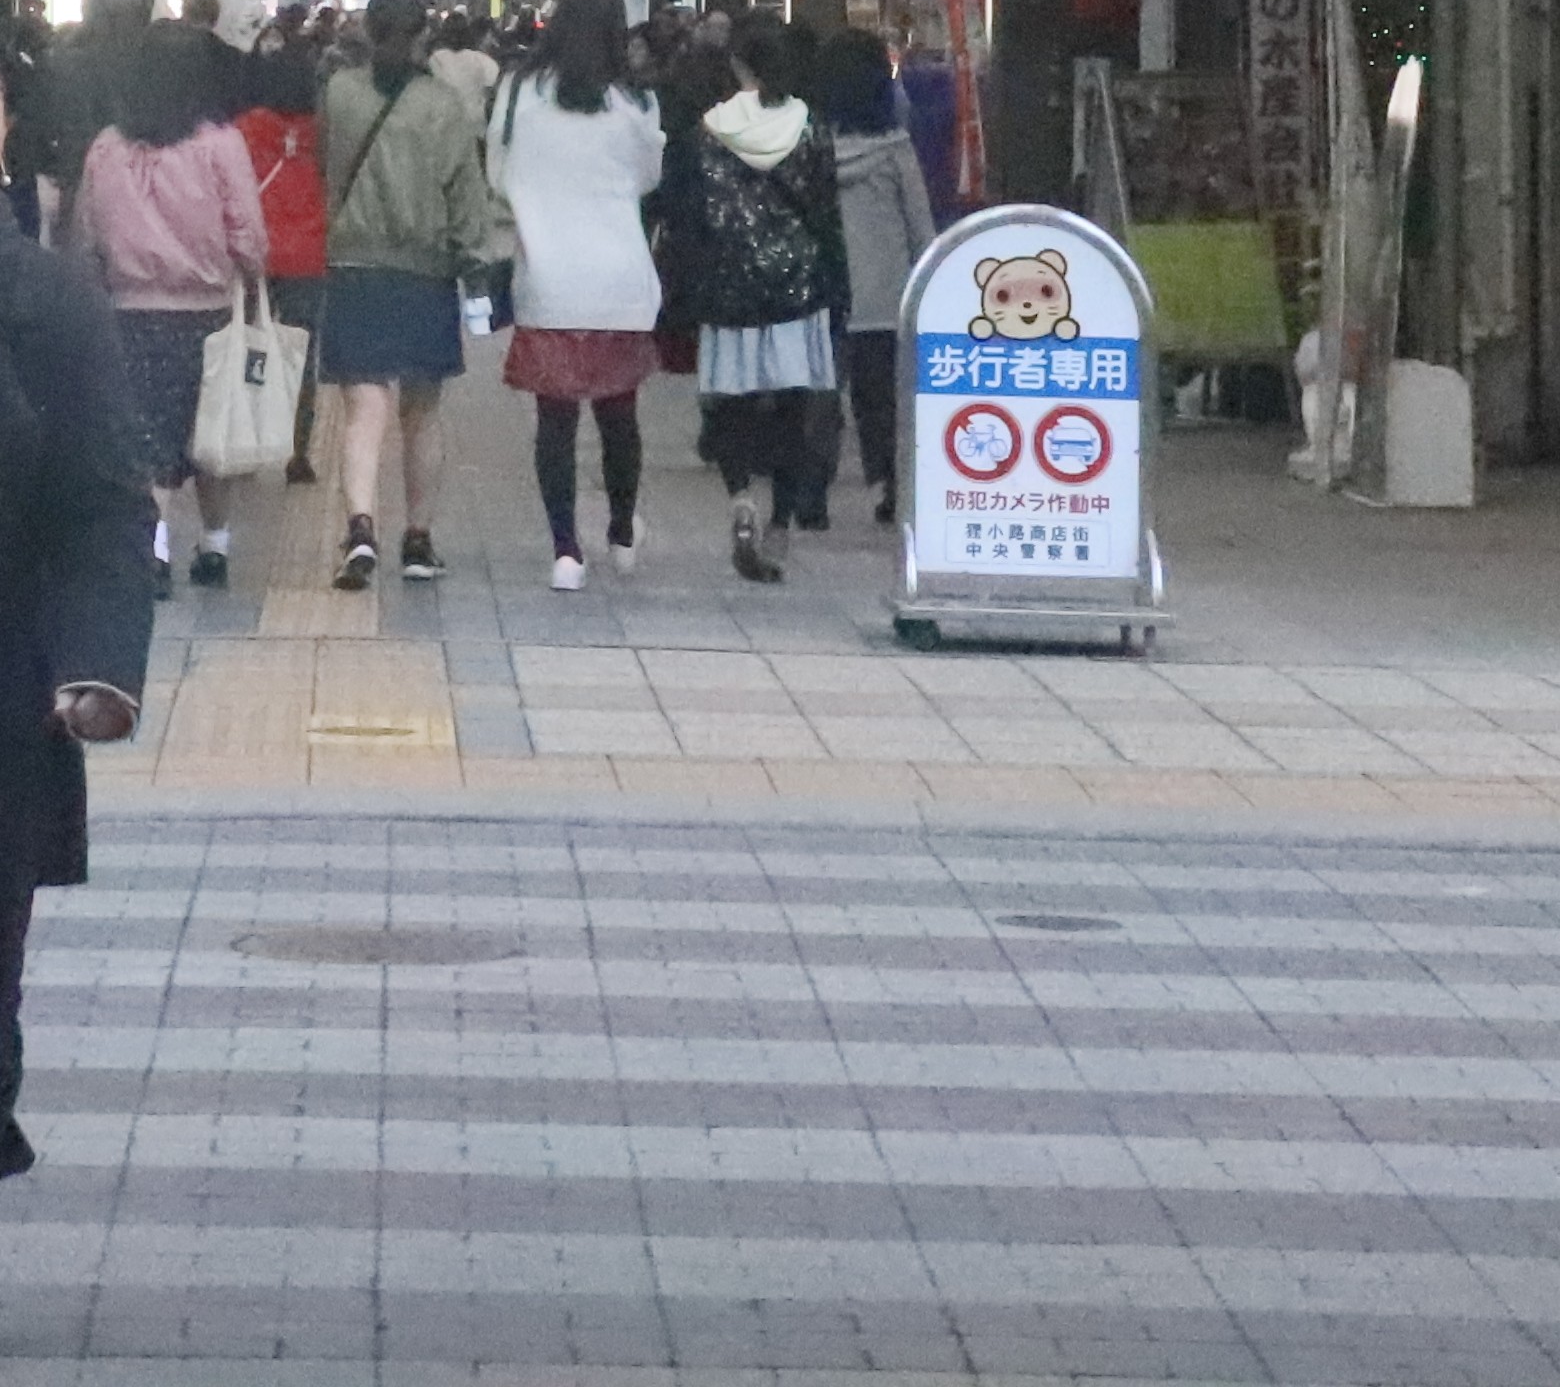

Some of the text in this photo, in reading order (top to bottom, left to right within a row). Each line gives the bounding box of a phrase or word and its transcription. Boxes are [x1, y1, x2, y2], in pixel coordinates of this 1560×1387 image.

[928, 345, 1127, 391] 歩行者専用
[946, 490, 1111, 513] 防犯カメラ作動中
[966, 524, 1089, 542] 狸小路商店街
[966, 543, 1090, 560] 中央警察署
